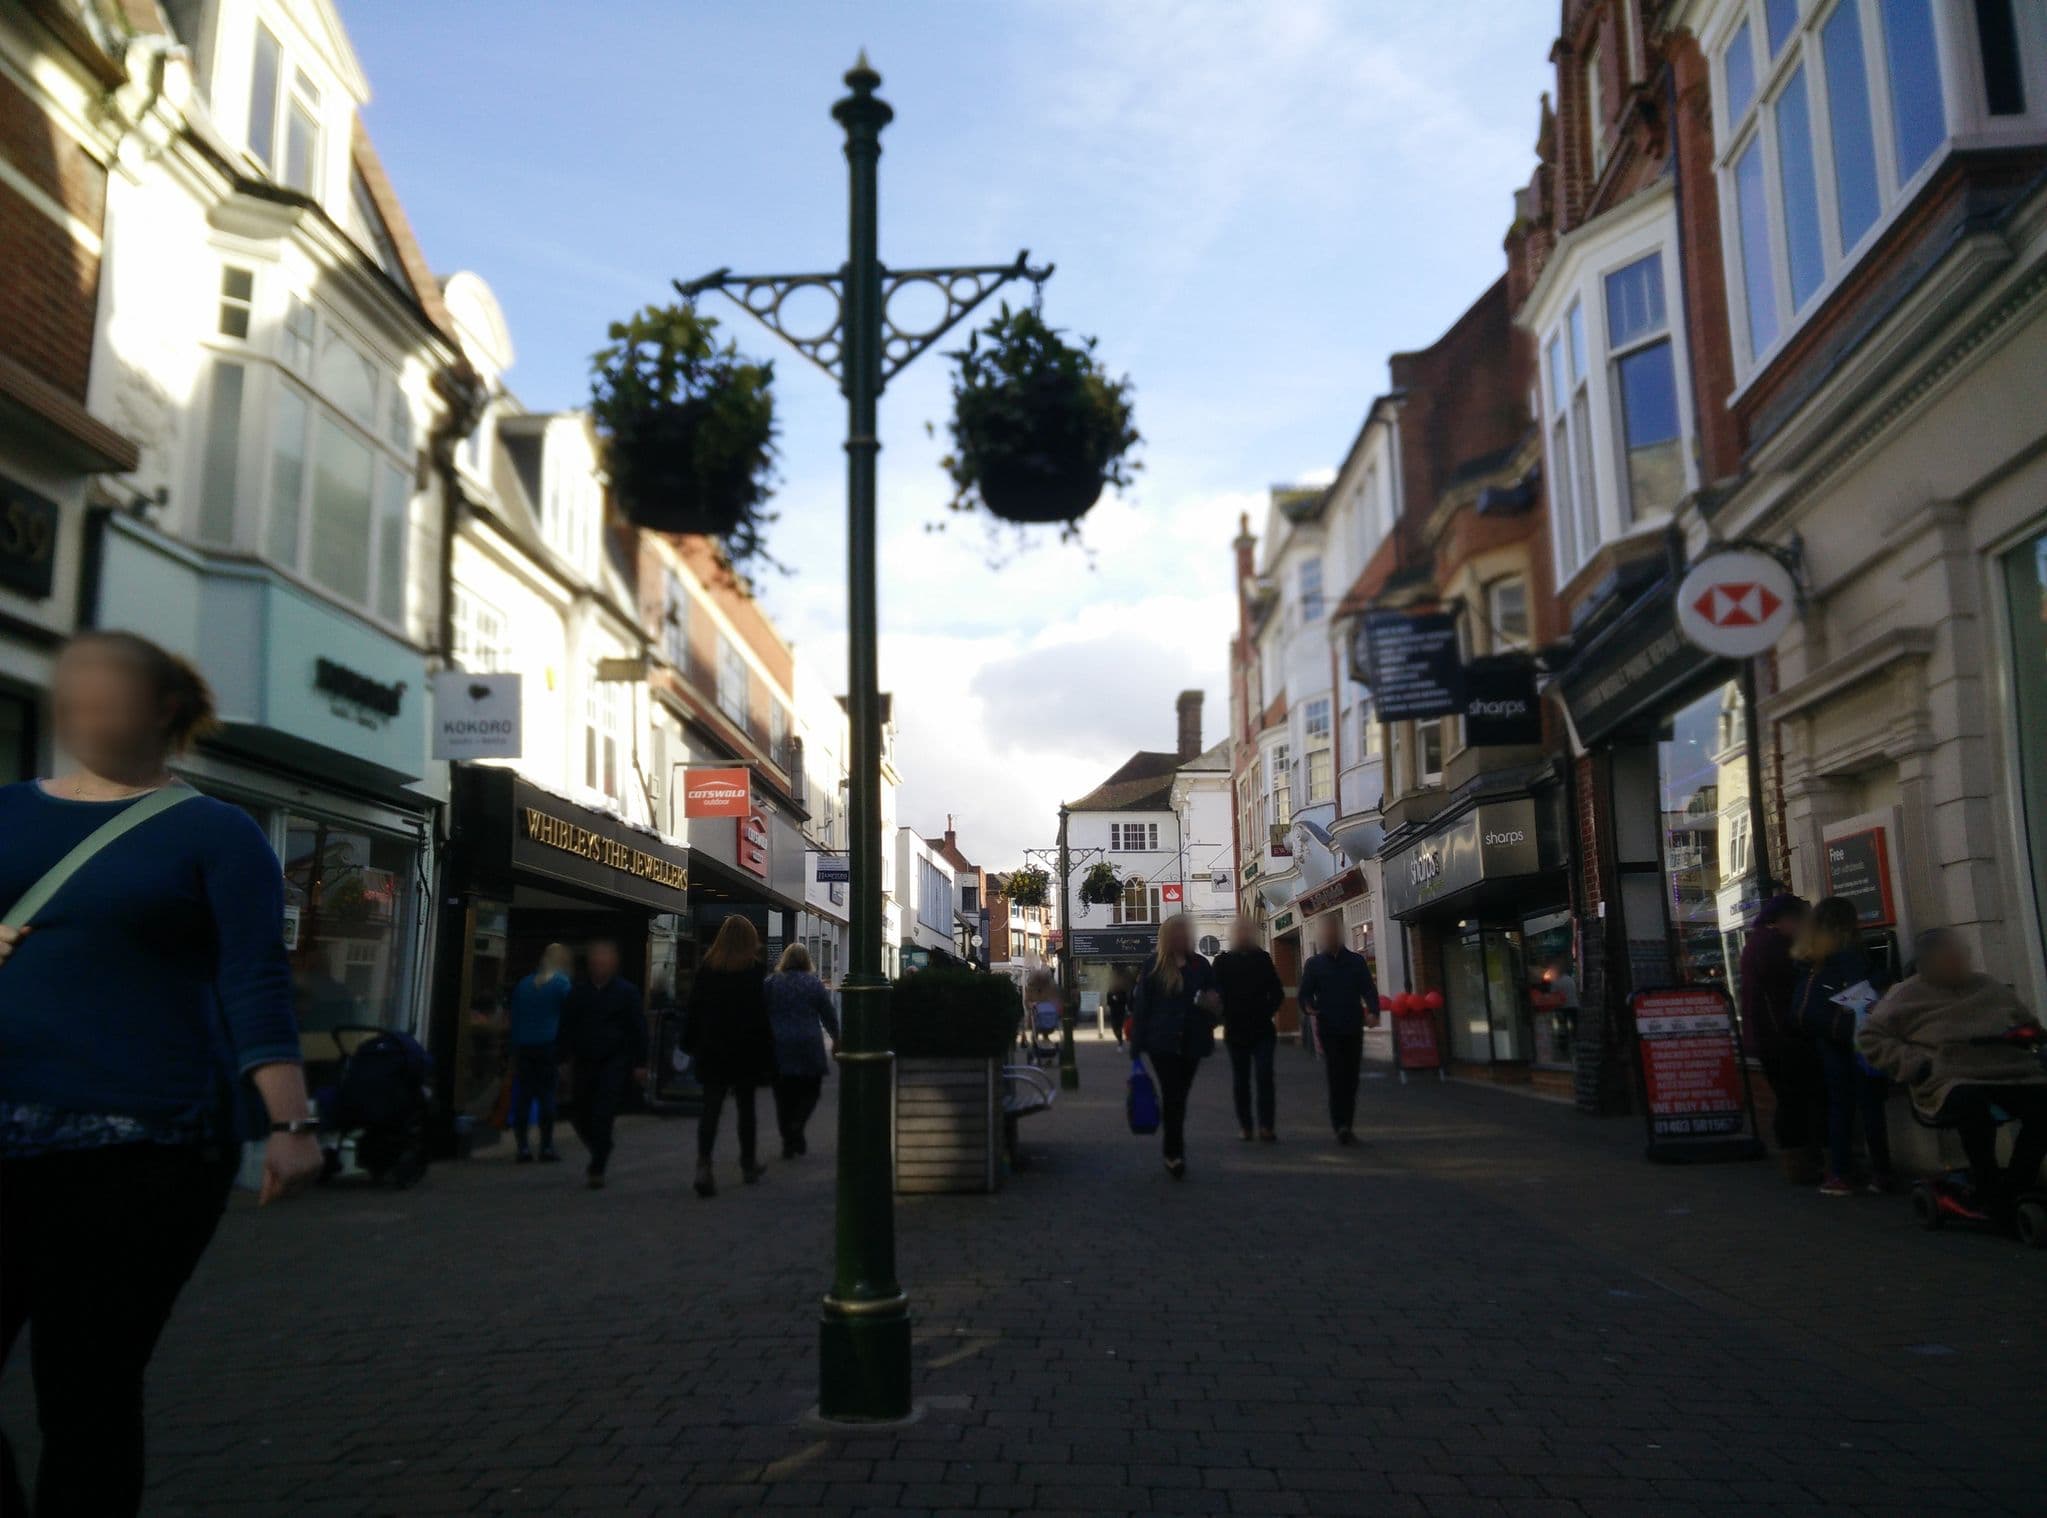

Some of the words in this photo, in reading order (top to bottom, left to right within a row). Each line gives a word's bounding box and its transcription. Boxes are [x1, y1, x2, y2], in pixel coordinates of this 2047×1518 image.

[1469, 699, 1526, 717] sharps
[443, 719, 513, 735] KOKORO
[688, 789, 746, 799] COTSWOLD
[704, 798, 731, 806] outdoor
[1485, 829, 1524, 846] sharps
[525, 806, 600, 861] WHIBLEYS
[602, 837, 629, 870] THE
[630, 849, 687, 892] JEWELLERS
[1828, 847, 1845, 862] Free
[1410, 851, 1435, 889] sharps
